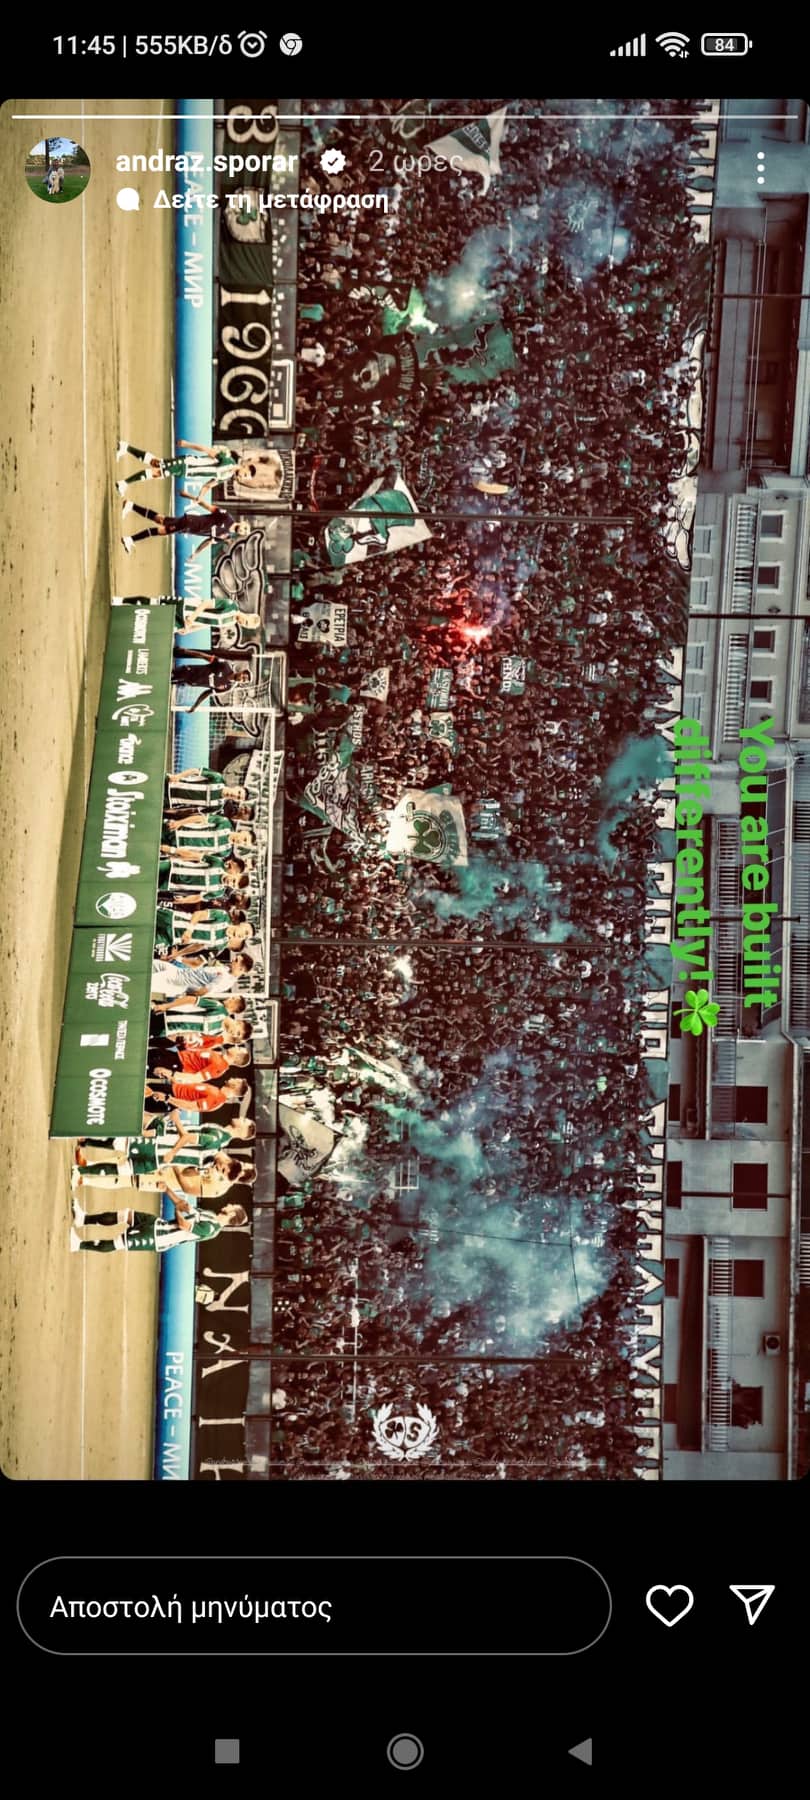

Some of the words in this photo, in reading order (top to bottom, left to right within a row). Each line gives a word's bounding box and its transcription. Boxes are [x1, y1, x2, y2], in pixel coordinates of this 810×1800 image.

[100, 788, 145, 859] Stoiximan
[86, 1079, 108, 1125] COSMOTE
[164, 1351, 184, 1418] PEACE
